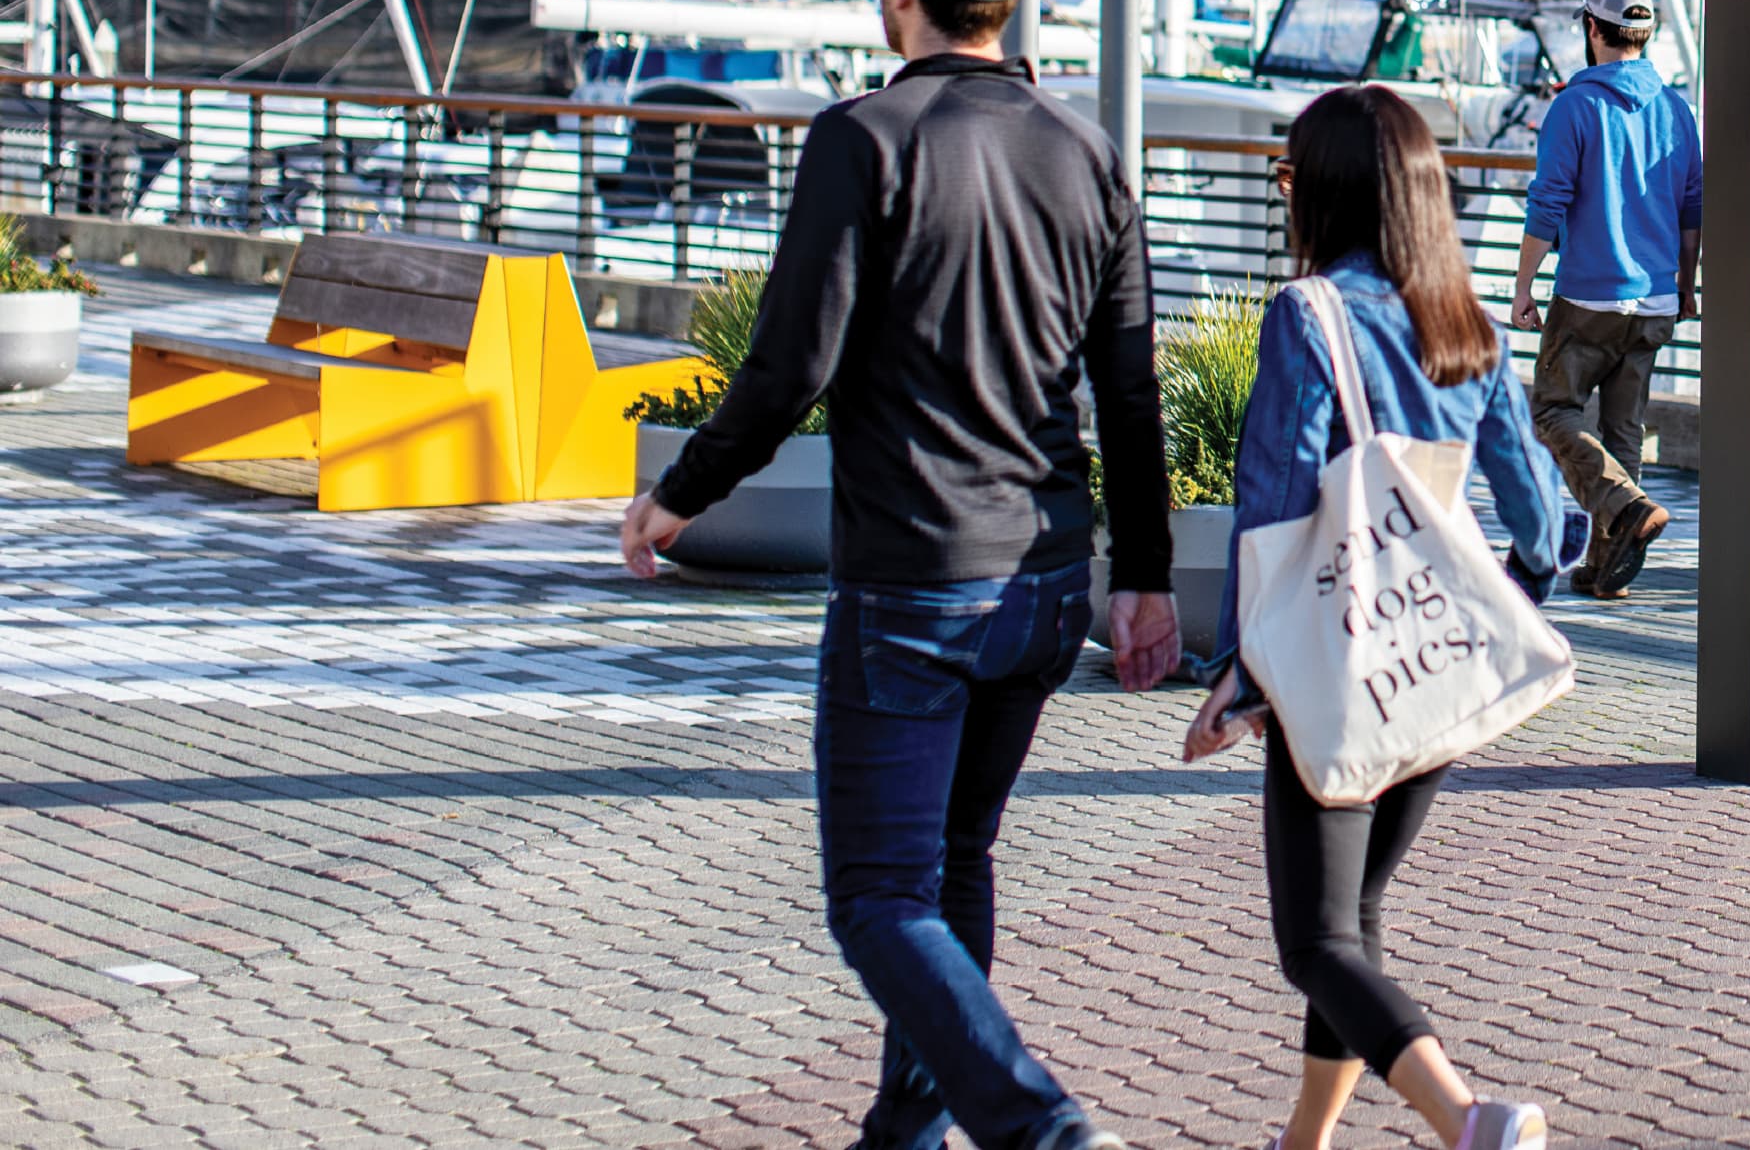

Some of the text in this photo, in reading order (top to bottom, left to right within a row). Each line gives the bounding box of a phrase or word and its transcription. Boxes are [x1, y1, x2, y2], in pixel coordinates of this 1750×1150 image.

[1316, 487, 1424, 596] send
[1342, 565, 1447, 637] dog
[1361, 627, 1486, 724] pics.
